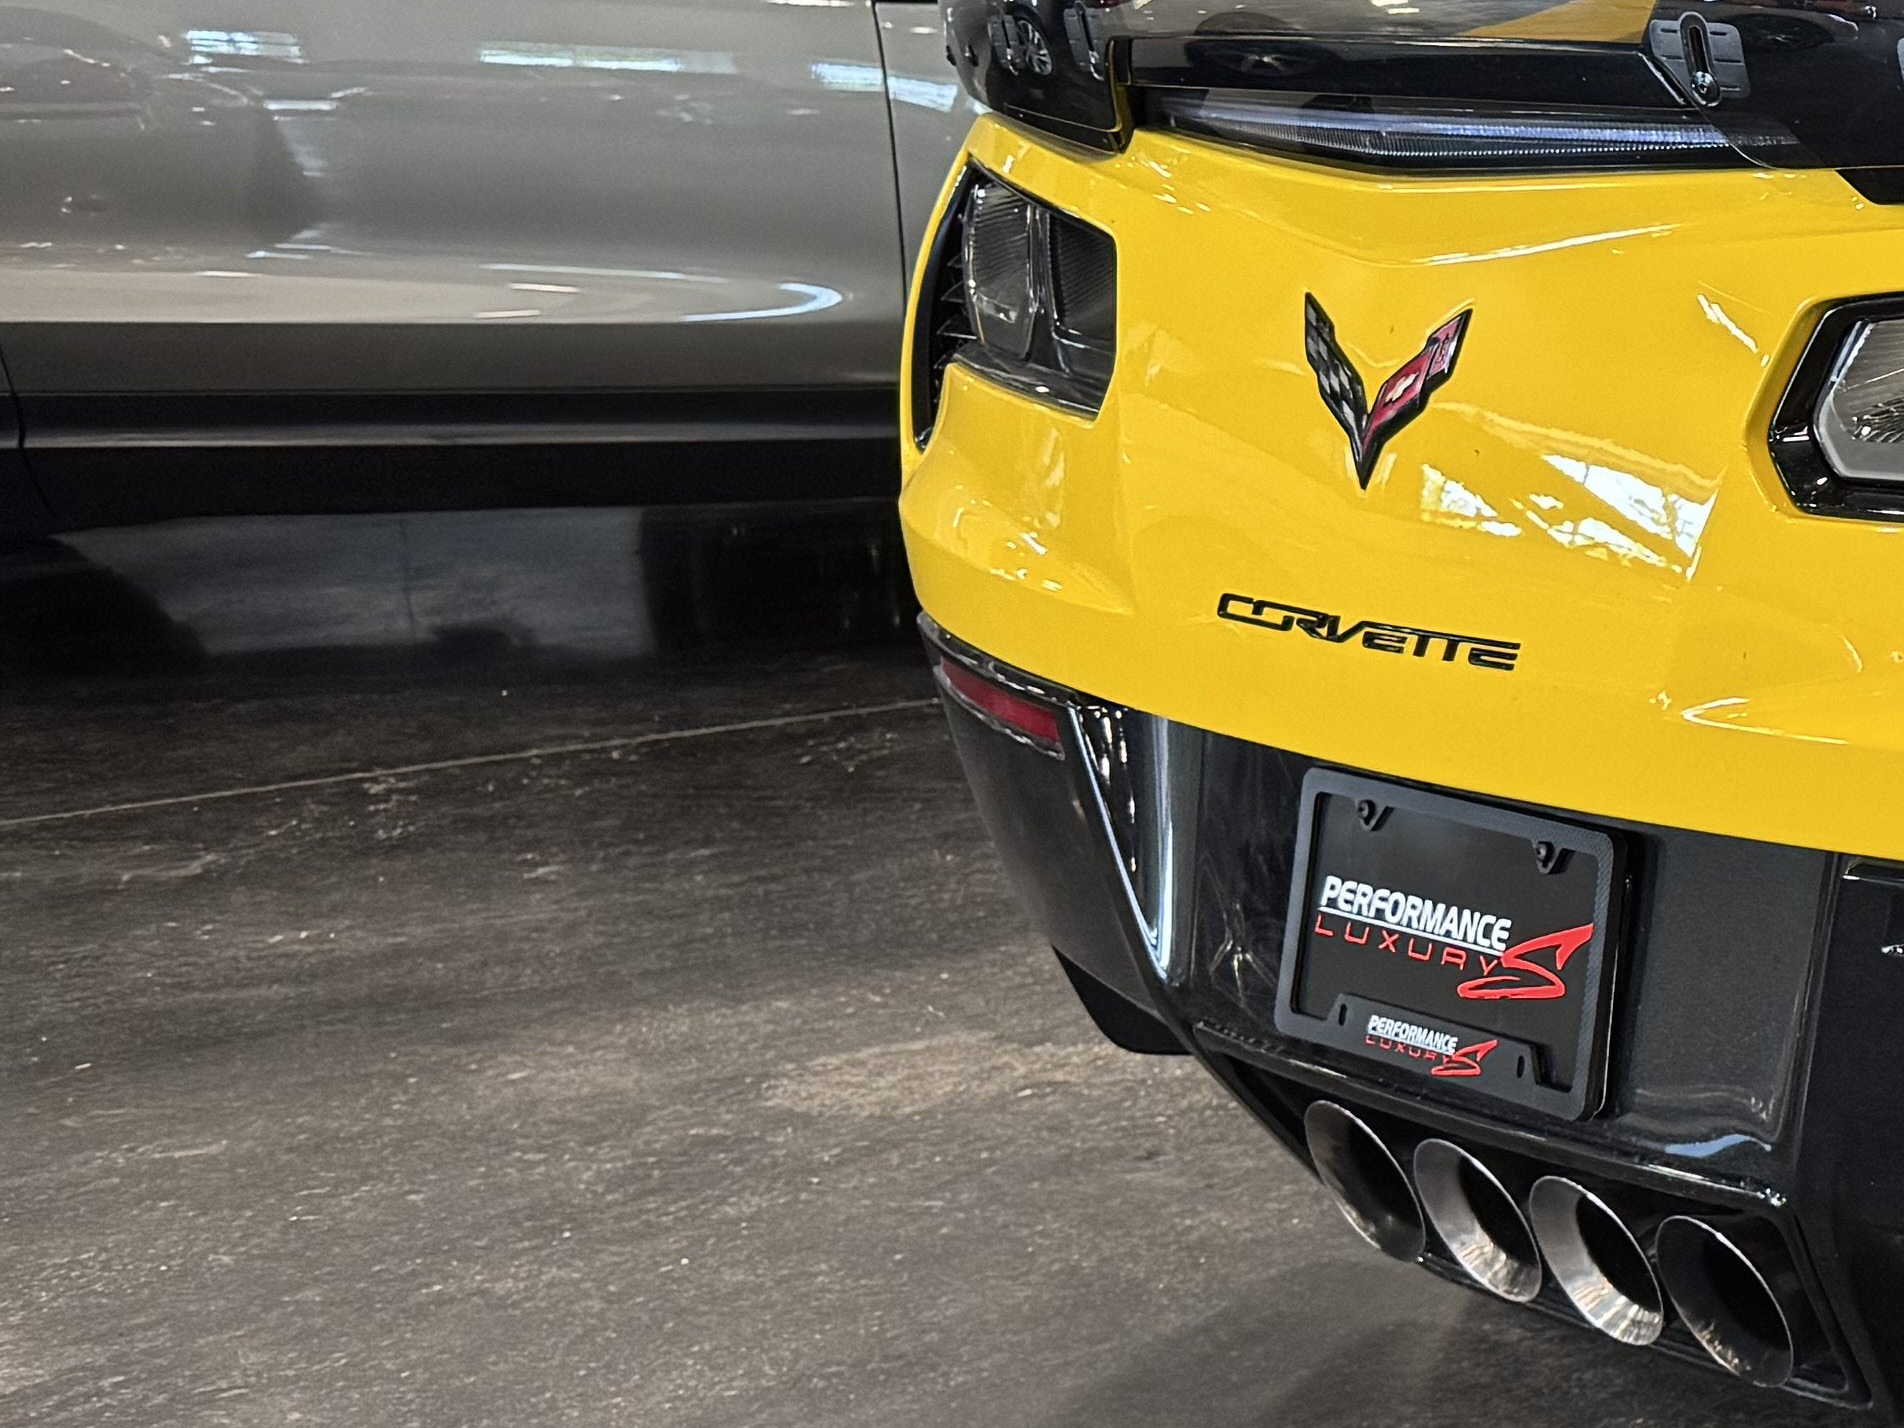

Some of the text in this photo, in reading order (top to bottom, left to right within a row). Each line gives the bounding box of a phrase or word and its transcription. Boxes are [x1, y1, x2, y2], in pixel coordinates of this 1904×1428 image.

[1217, 592, 1521, 671] CORVETTE
[1314, 914, 1499, 966] LUXURY
[1320, 875, 1512, 951] PERFORMANCE
[1367, 1014, 1458, 1055] PERFORMANCE
